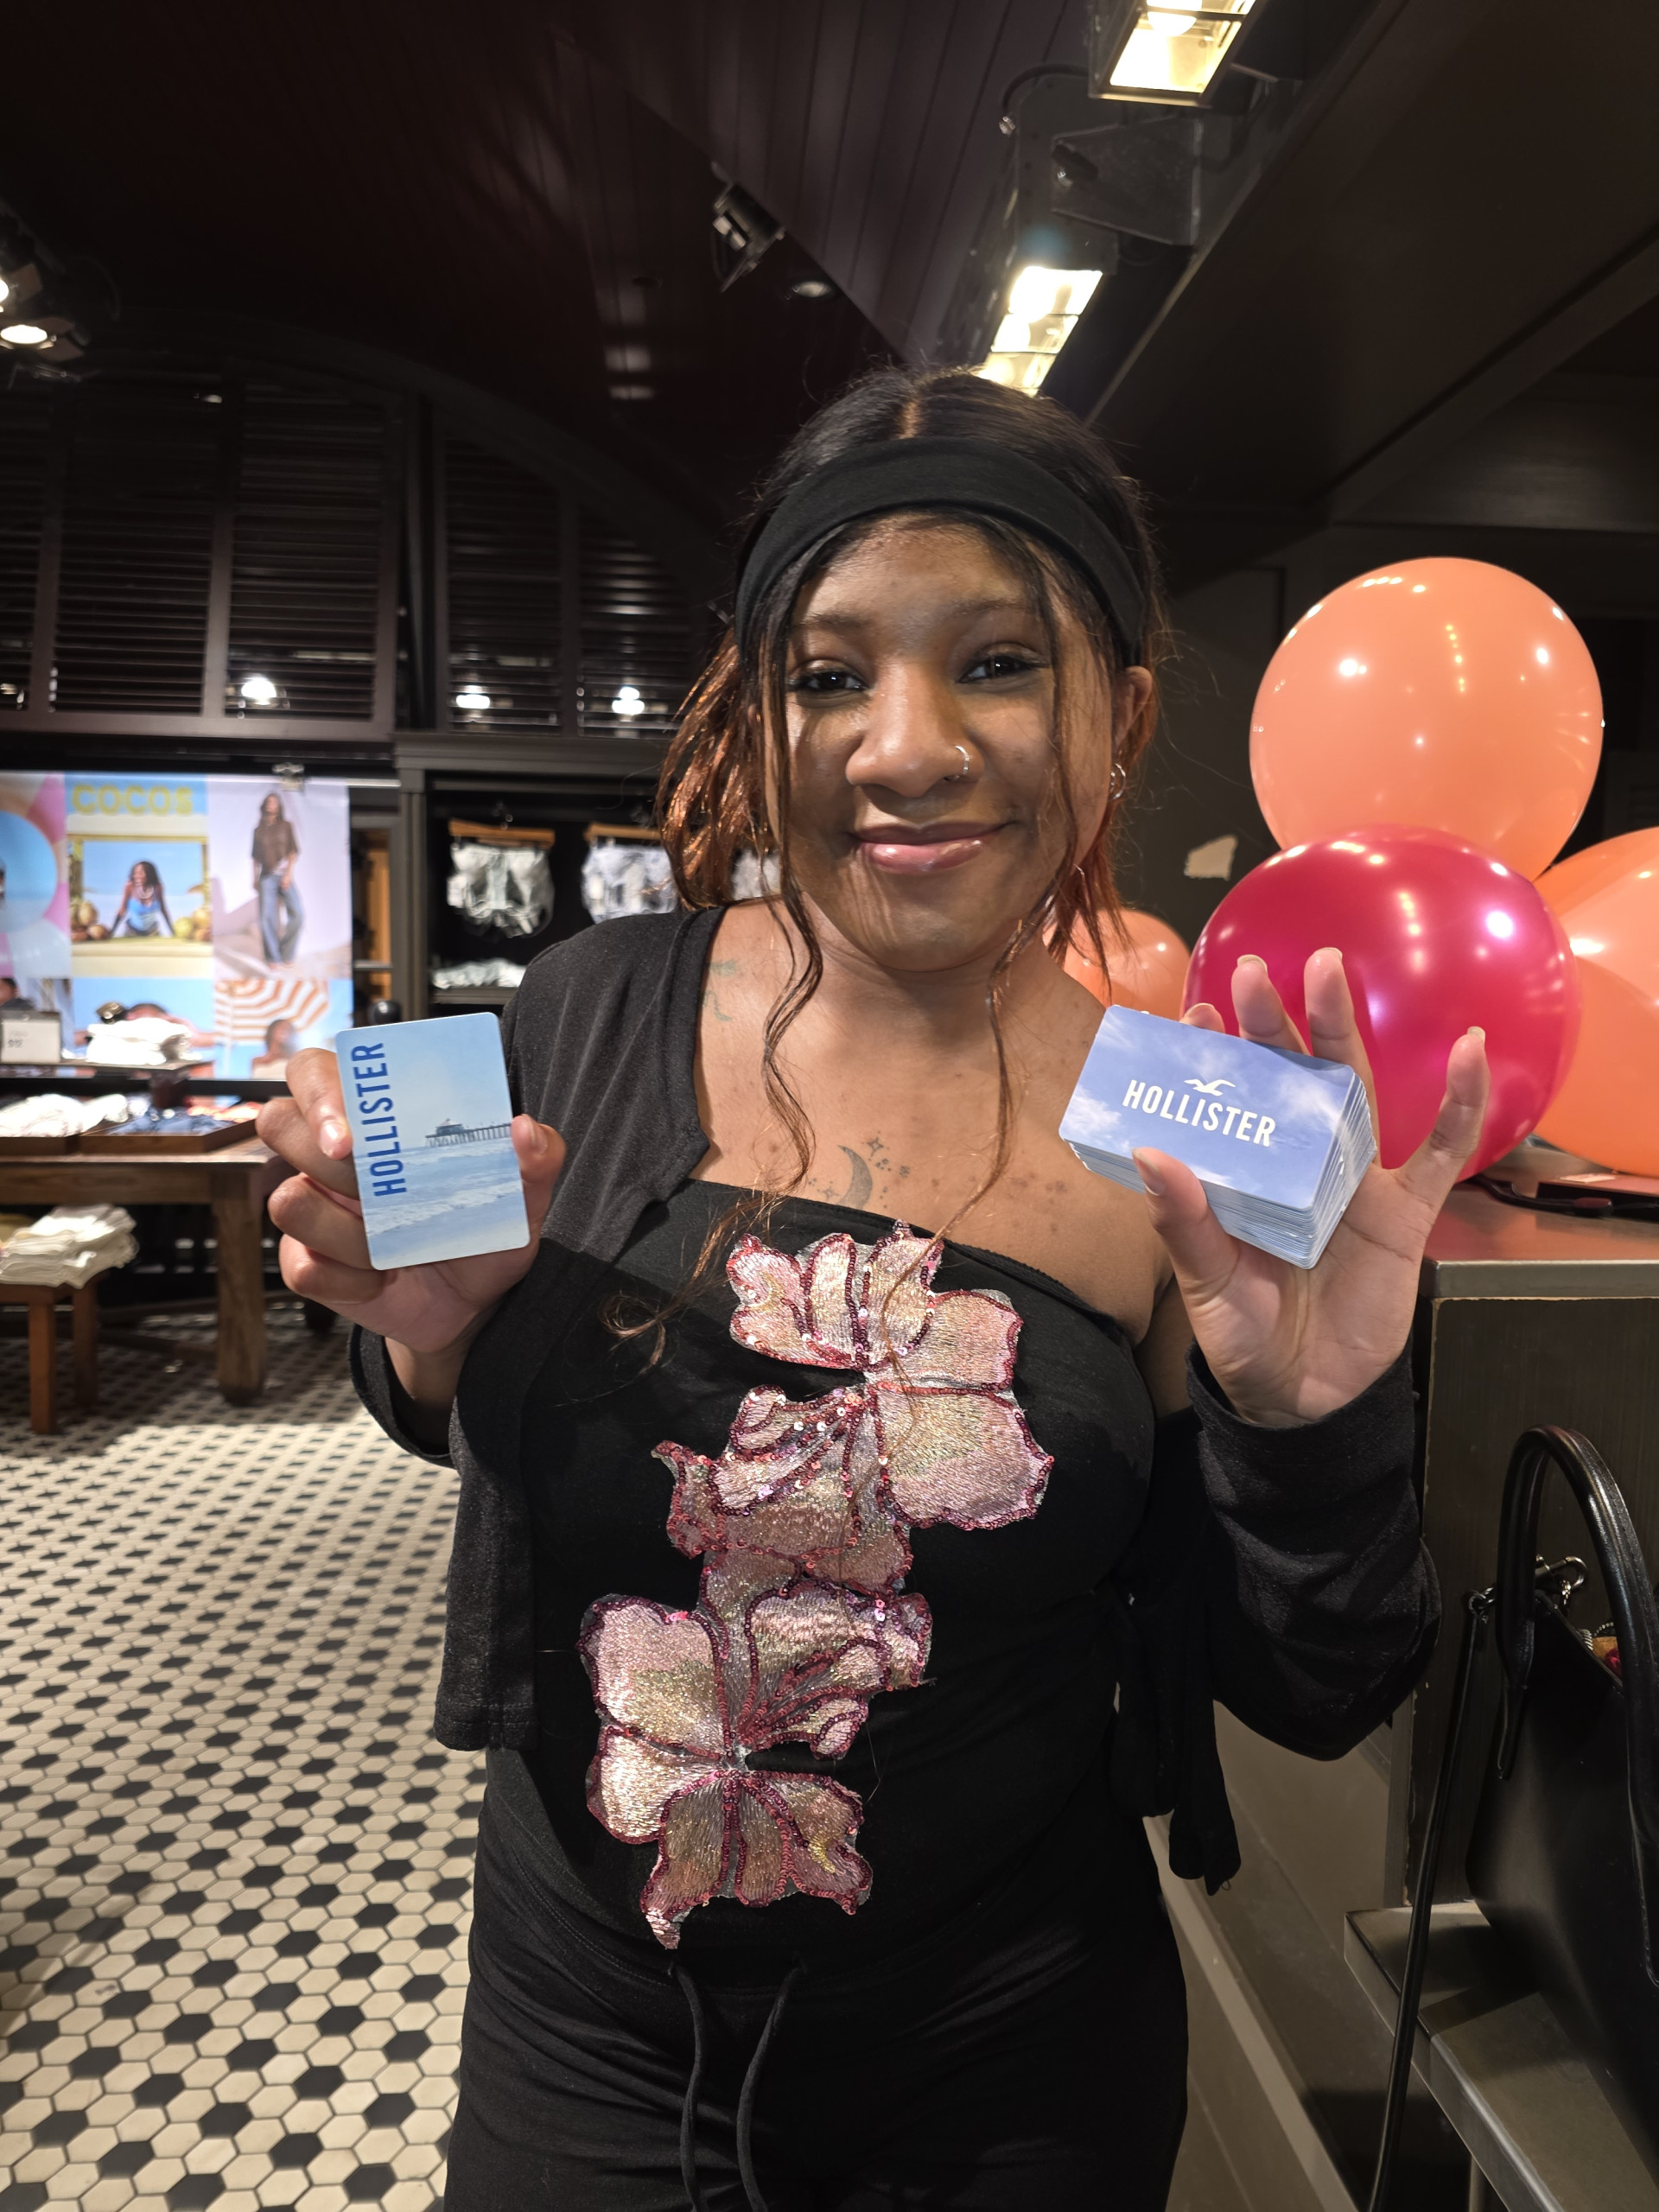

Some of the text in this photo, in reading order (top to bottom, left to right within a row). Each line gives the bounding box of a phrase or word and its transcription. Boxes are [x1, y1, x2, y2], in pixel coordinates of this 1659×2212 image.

[72, 783, 193, 816] COCOS
[351, 1042, 407, 1197] HOLLISTER
[1122, 1079, 1276, 1147] HOLLISTER
